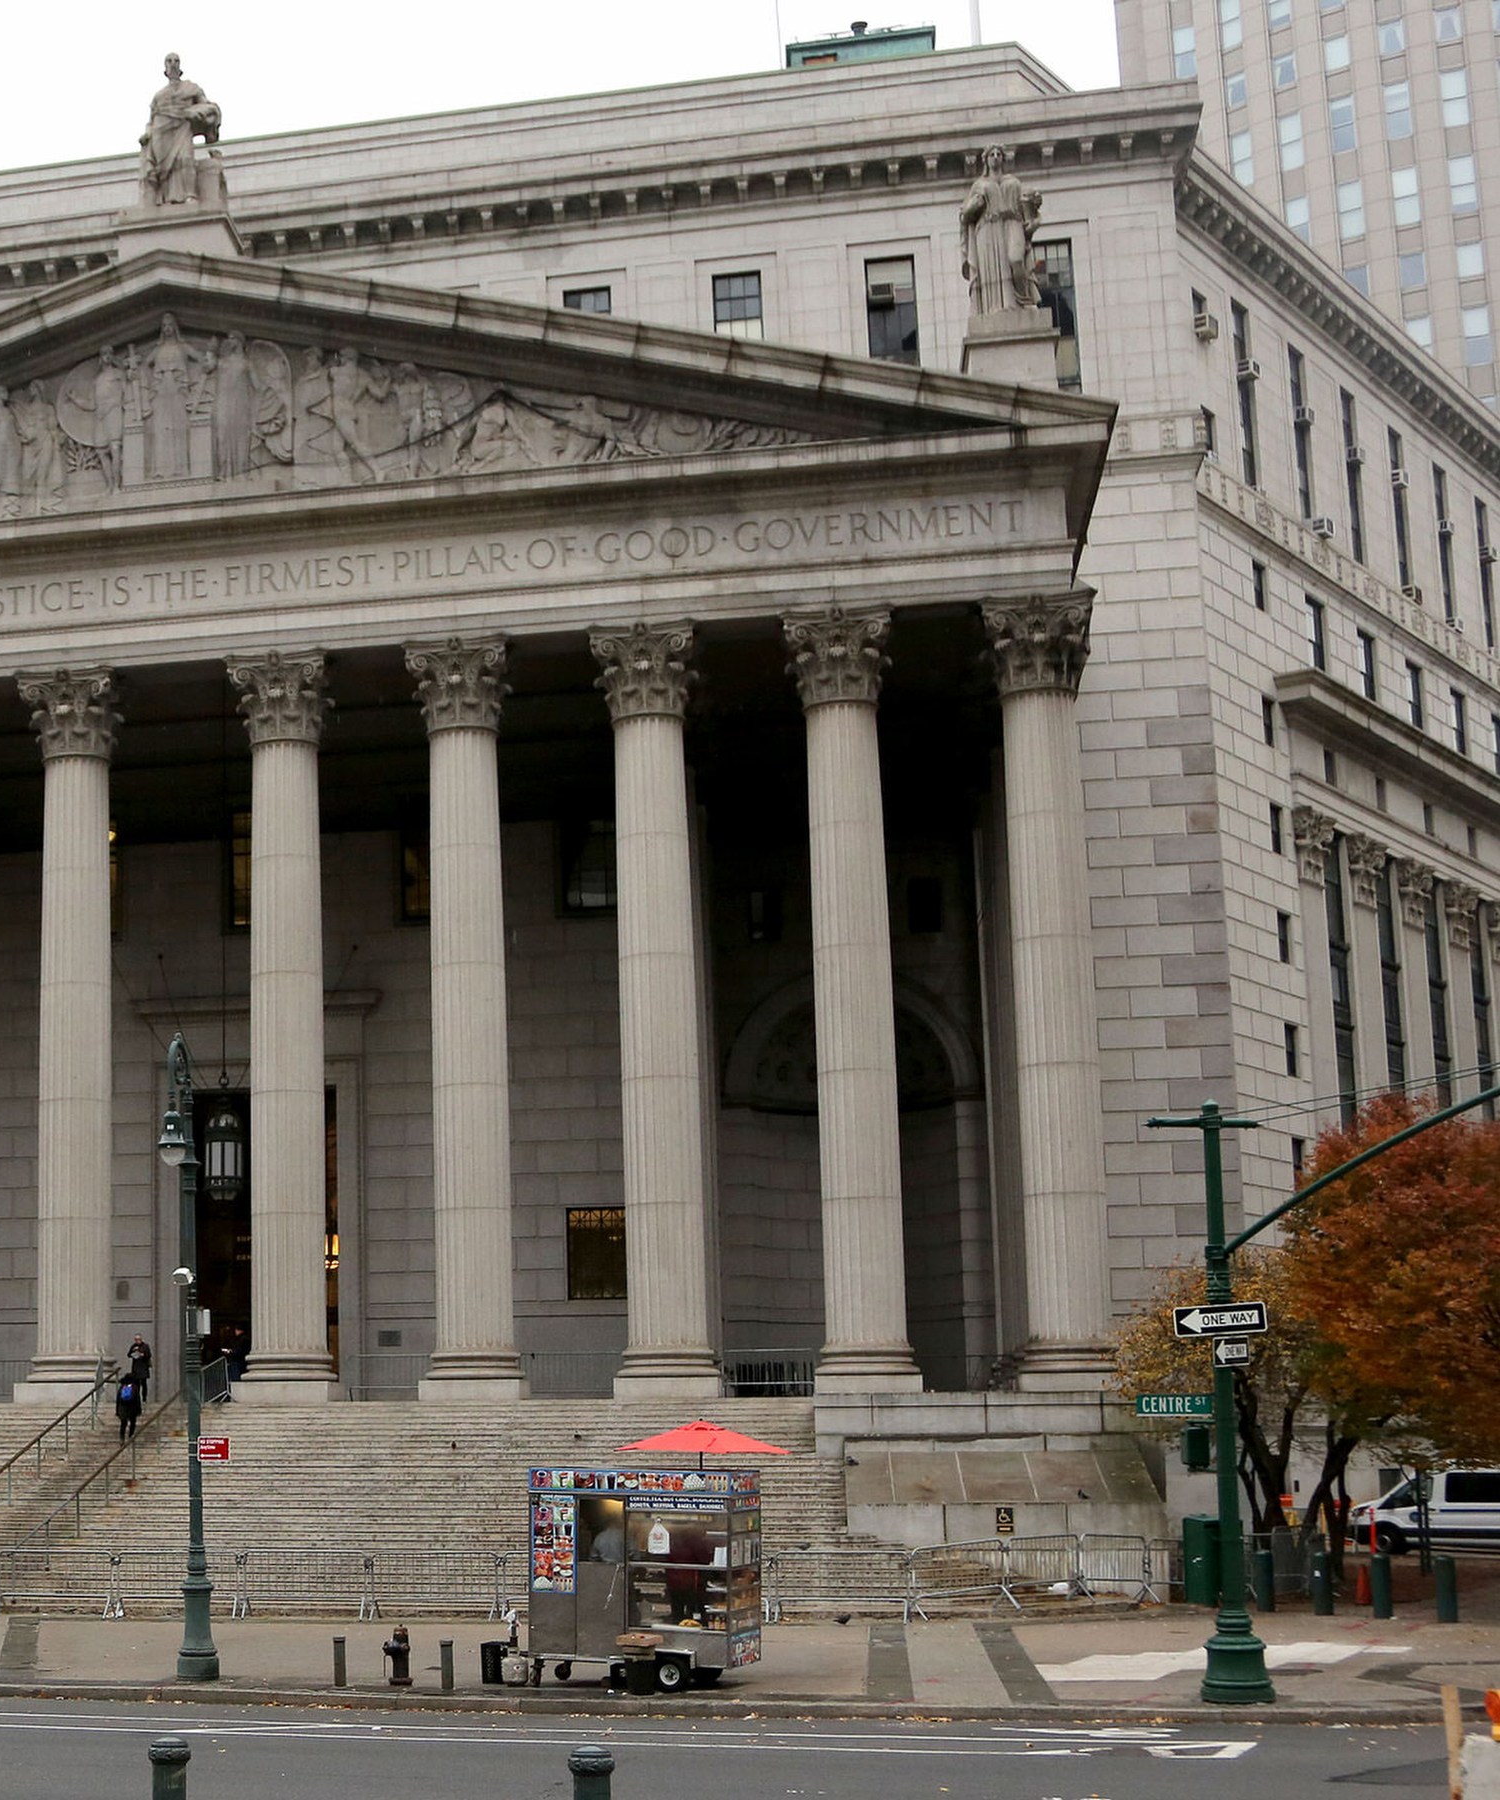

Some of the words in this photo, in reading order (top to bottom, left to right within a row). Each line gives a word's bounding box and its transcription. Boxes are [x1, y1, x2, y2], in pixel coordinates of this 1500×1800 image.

[100, 575, 131, 608] IS
[143, 568, 208, 605] THE
[224, 553, 377, 598] FIRMEST
[393, 541, 517, 583] PILLAR
[526, 536, 578, 570] OF
[594, 525, 716, 564] GOOD
[733, 500, 1024, 553] GOVERNMENT
[1201, 1313, 1227, 1326] ONE
[1229, 1311, 1255, 1324] WAY
[1142, 1396, 1193, 1413] CENTRE
[1194, 1396, 1206, 1406] ST
